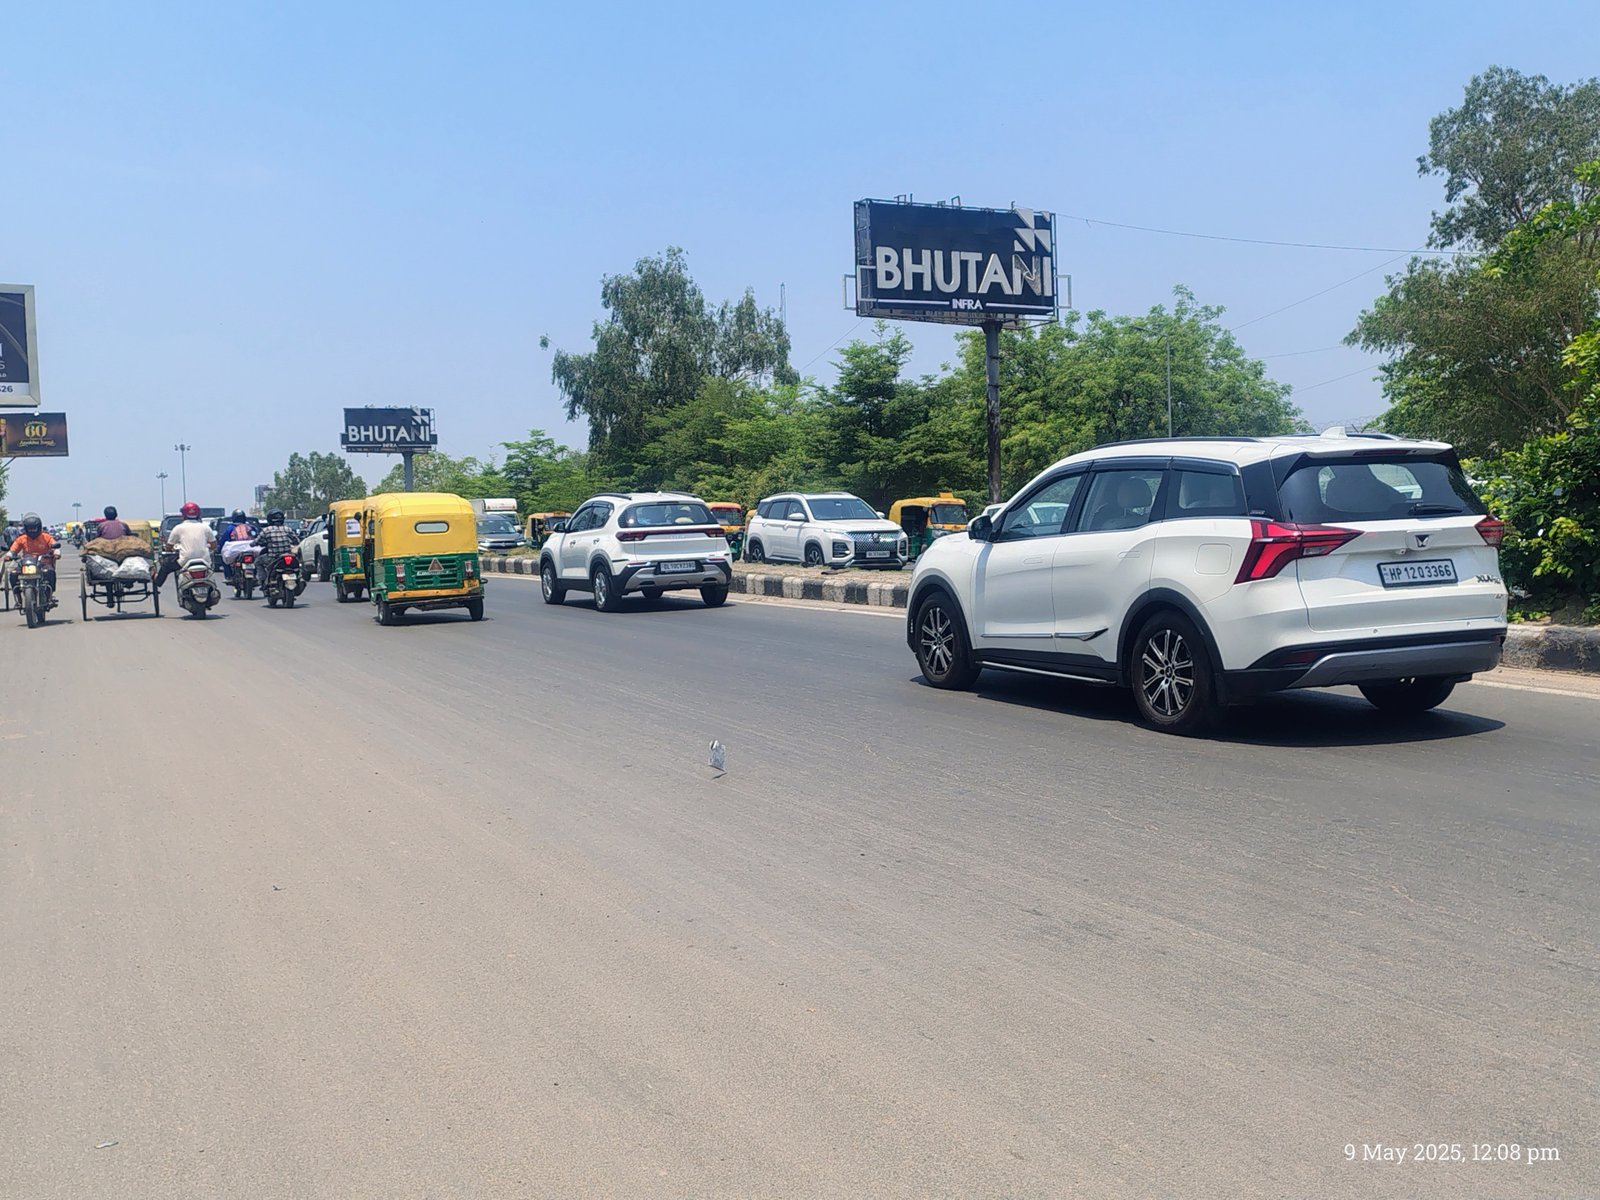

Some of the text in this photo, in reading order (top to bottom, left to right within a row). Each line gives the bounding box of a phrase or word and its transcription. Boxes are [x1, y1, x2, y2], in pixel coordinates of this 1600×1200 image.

[875, 246, 1052, 297] BHUTANI
[952, 298, 983, 310] INFRA
[347, 425, 430, 442] BHUTANI
